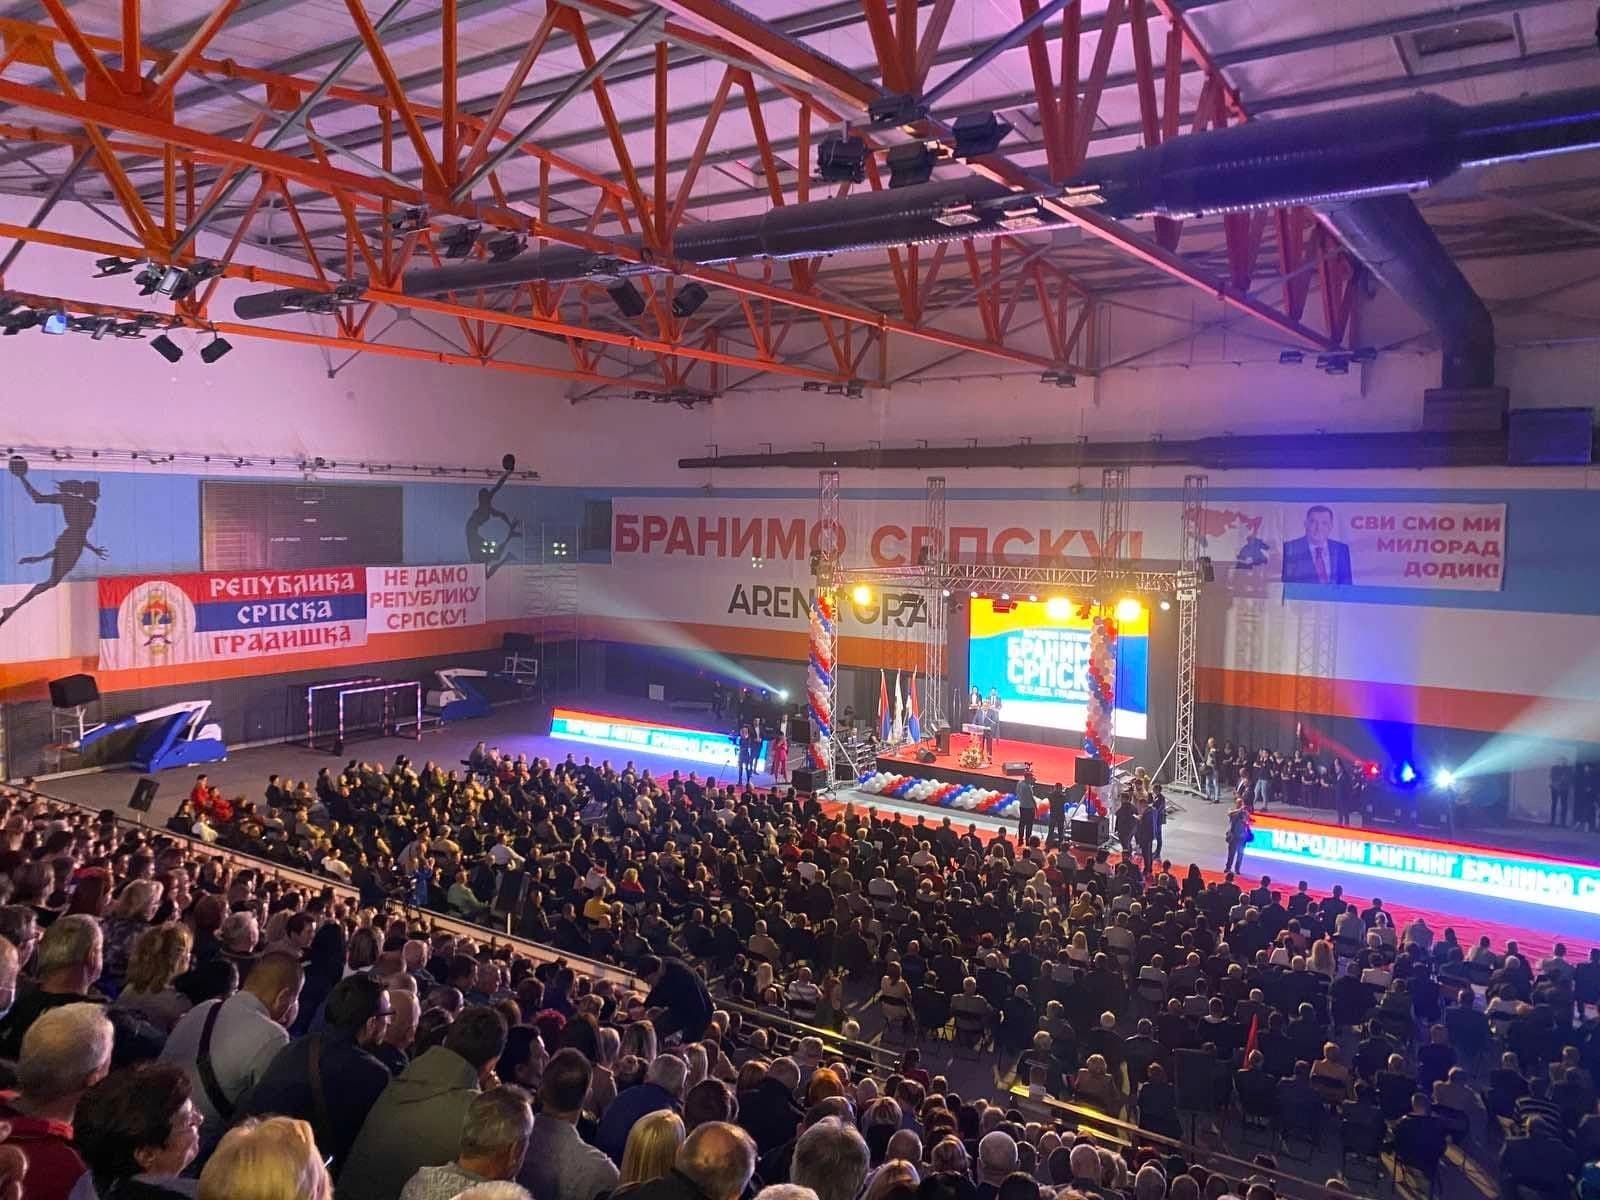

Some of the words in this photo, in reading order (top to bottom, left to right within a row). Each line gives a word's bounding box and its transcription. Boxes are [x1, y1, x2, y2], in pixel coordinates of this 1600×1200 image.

[615, 513, 847, 561] БРАНИМО
[1350, 515, 1396, 531] СВИ
[1402, 515, 1455, 532] СМО
[1462, 516, 1500, 532] МИ
[1376, 537, 1500, 557] МИЛОРАД
[209, 570, 356, 598] РЕПУБЛИКА
[384, 568, 410, 586] НЕ
[414, 566, 469, 587] ДАМО
[1403, 562, 1499, 579] ДОДИК!
[236, 594, 333, 624] СРПСКА
[369, 586, 481, 609] РЕПУБЛИКУ
[727, 583, 843, 623] AREN
[386, 606, 468, 631] СРПСКУ!
[213, 624, 352, 655] ГРАДИШКА
[1007, 636, 1091, 663] БРАНИМ
[1007, 658, 1090, 692] СРПСК
[1371, 843, 1458, 878] МИТИНГ
